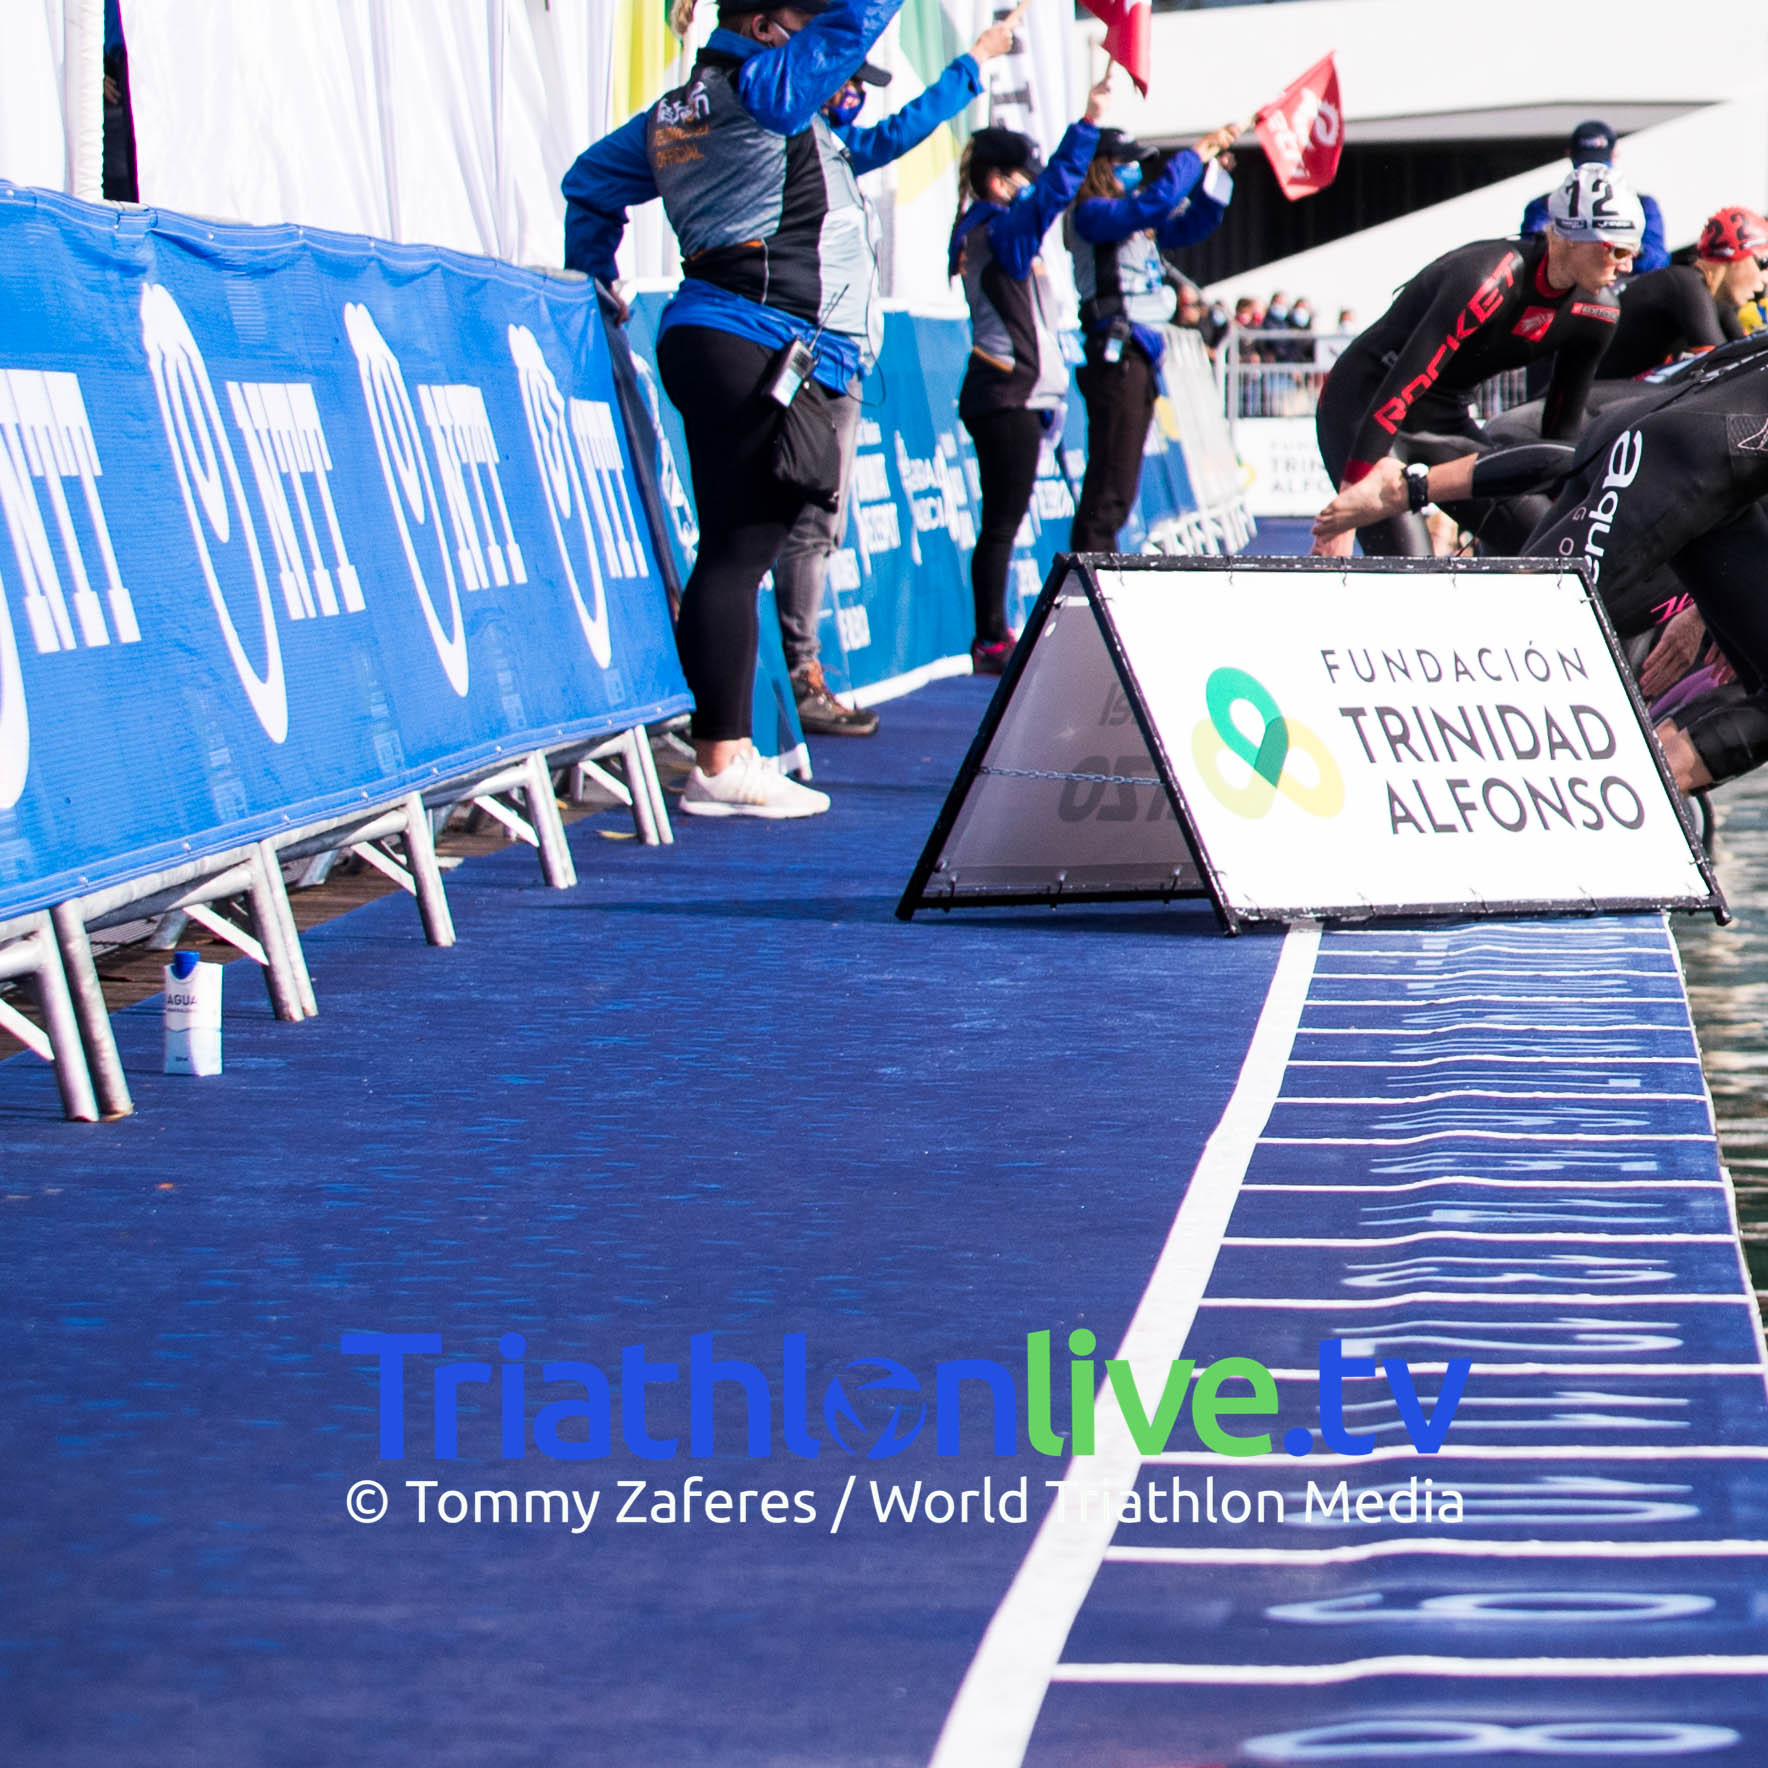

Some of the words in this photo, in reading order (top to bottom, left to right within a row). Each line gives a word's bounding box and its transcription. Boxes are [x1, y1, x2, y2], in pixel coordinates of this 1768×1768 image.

[1565, 178, 1620, 219] 12
[1705, 212, 1751, 251] 22
[226, 380, 366, 621] NTT
[417, 383, 528, 592] NTT
[569, 396, 650, 579] NTT
[1320, 640, 1590, 684] FUNDACIÓN
[1338, 704, 1617, 764] TRINIDAD
[1386, 774, 1645, 835] ALFONSO
[1386, 1069, 1641, 1087] 17
[1371, 1107, 1651, 1129] 16
[1370, 1149, 1658, 1174] 15
[1358, 1197, 1684, 1226] 14
[1342, 1254, 1677, 1288] 13
[1333, 1317, 1685, 1357] 12
[1242, 1720, 1741, 1759] 8
